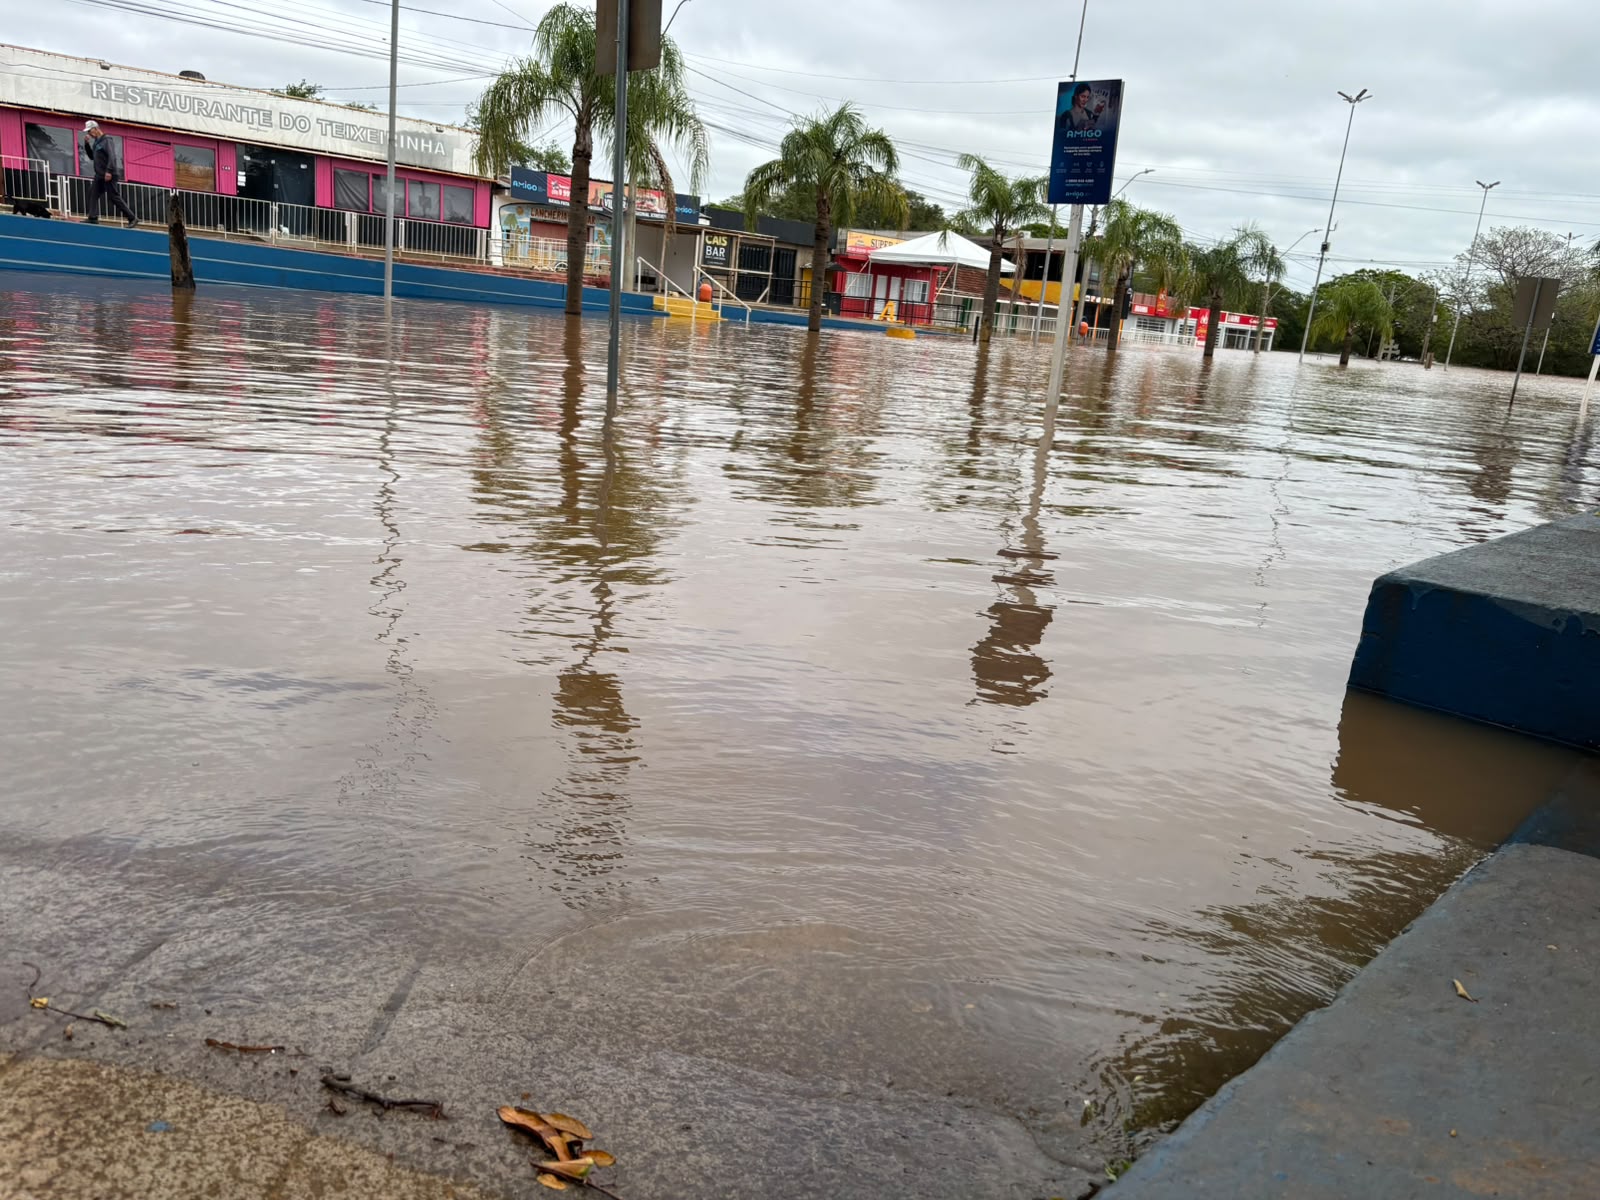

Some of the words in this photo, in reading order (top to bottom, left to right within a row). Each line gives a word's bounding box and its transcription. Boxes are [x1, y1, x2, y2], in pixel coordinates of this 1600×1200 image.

[90, 80, 273, 127] RESTAURANTE
[279, 112, 312, 133] DO
[1066, 128, 1102, 138] AMIGO
[512, 180, 537, 192] AMIGO
[705, 235, 728, 247] CAIS
[705, 245, 726, 257] BAR
